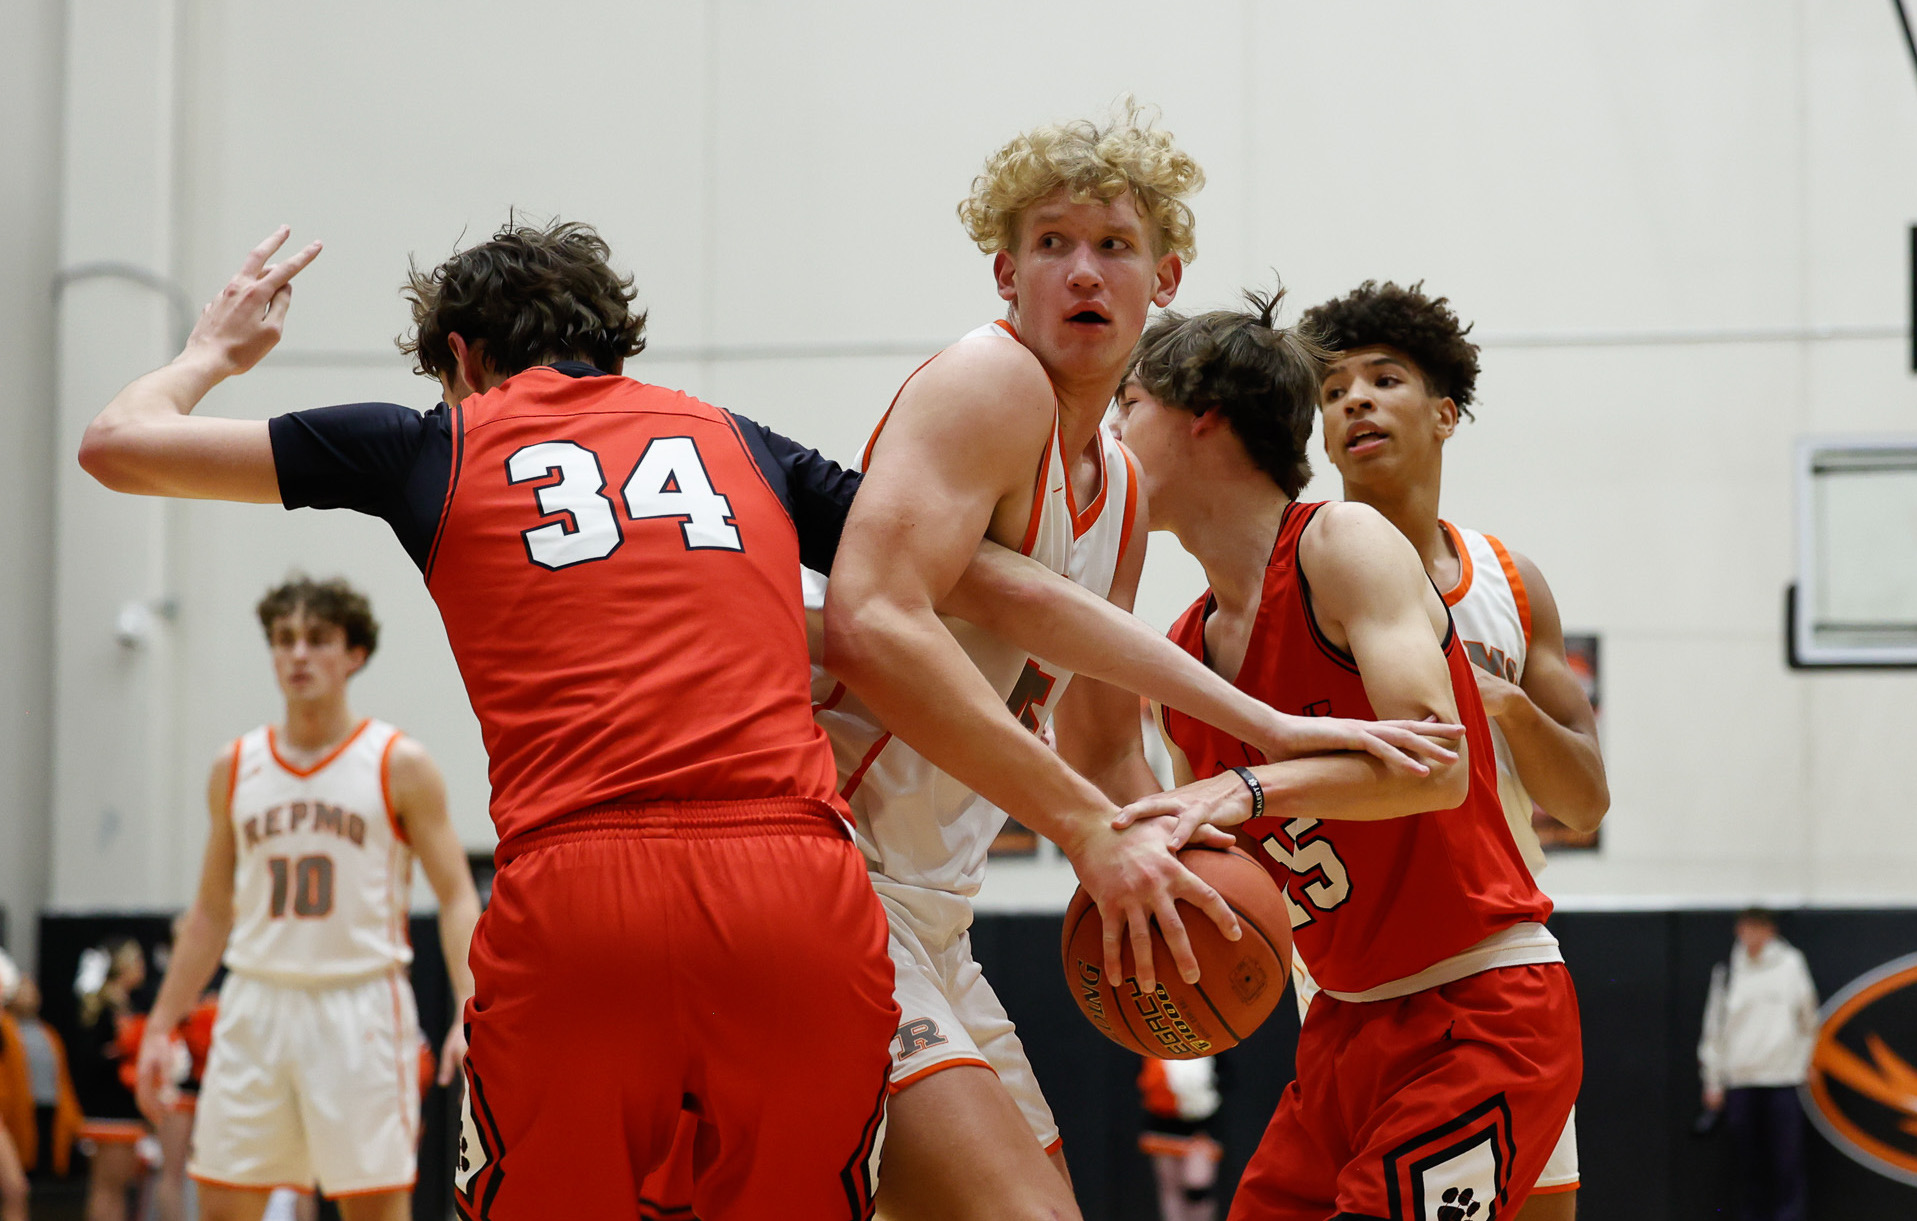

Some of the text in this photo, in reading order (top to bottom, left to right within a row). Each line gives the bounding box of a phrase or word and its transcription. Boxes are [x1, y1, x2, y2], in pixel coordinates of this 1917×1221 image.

[504, 436, 746, 572] 34
[268, 855, 335, 920] 10
[893, 1017, 949, 1062] R
[1154, 982, 1197, 1042] 1000
